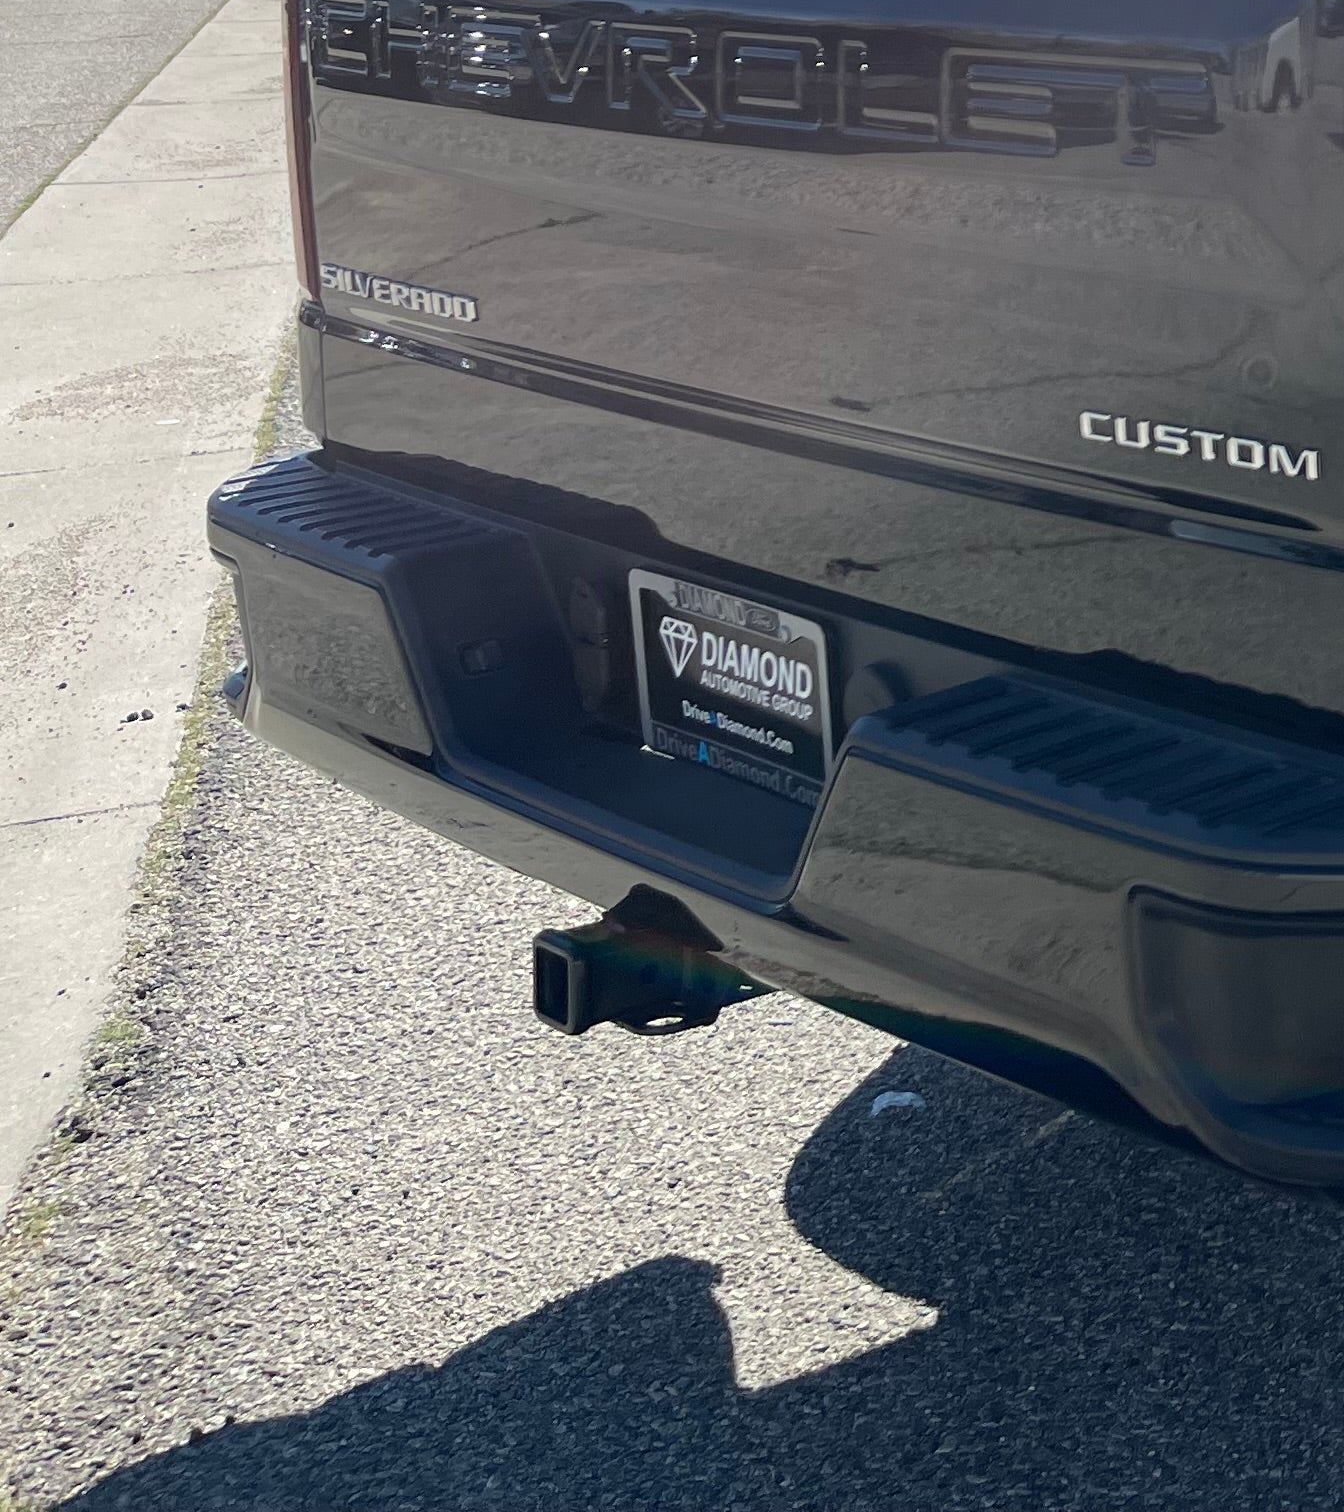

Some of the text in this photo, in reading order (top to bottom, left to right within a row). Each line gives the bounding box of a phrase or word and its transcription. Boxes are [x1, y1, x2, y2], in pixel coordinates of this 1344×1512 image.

[320, 262, 480, 322] SILVERADO
[1079, 411, 1320, 481] CUSTOM
[674, 580, 748, 627] DIAMOND
[701, 631, 813, 699] DIAMOND
[700, 670, 814, 721] AUTOMOTIVE GROUP
